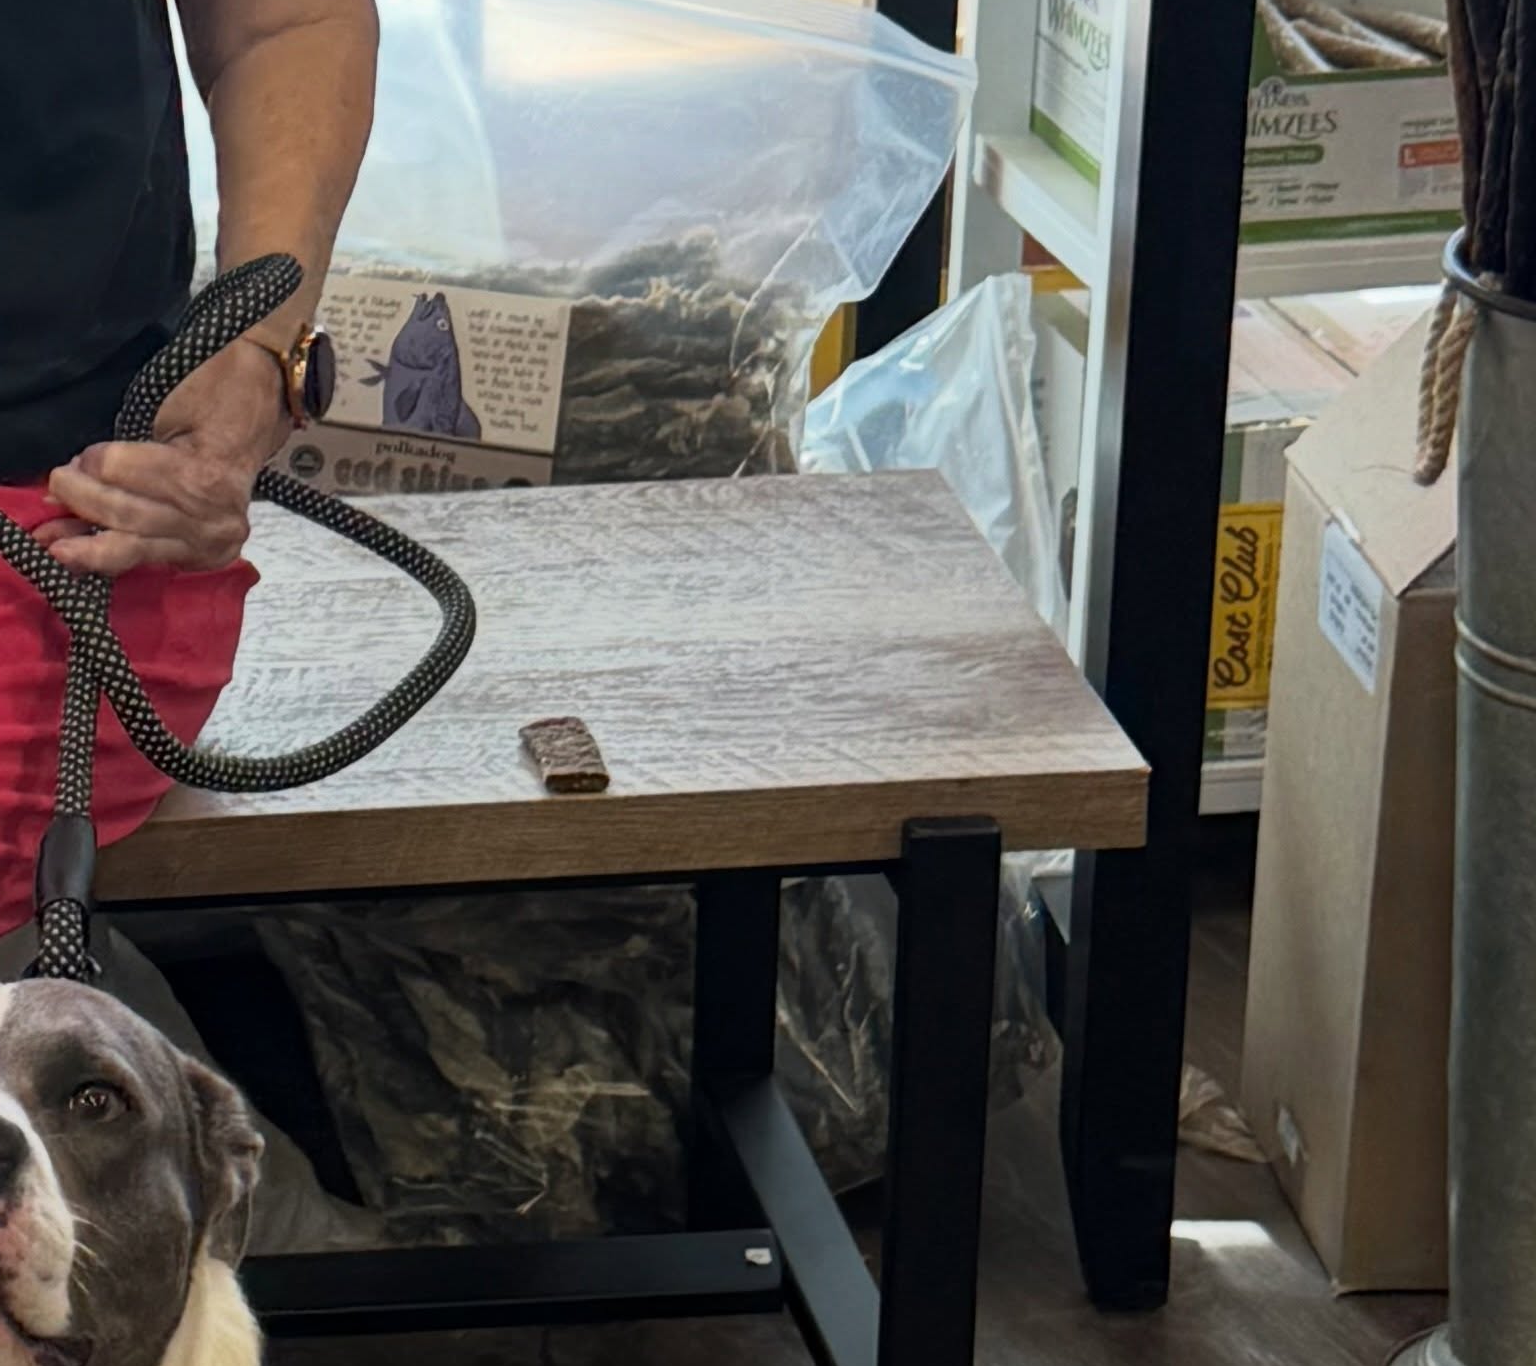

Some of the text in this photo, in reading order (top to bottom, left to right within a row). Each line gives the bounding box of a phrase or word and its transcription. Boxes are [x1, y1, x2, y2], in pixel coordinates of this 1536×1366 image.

[375, 439, 457, 465] polkadog
[1213, 525, 1260, 688] Cost Club
